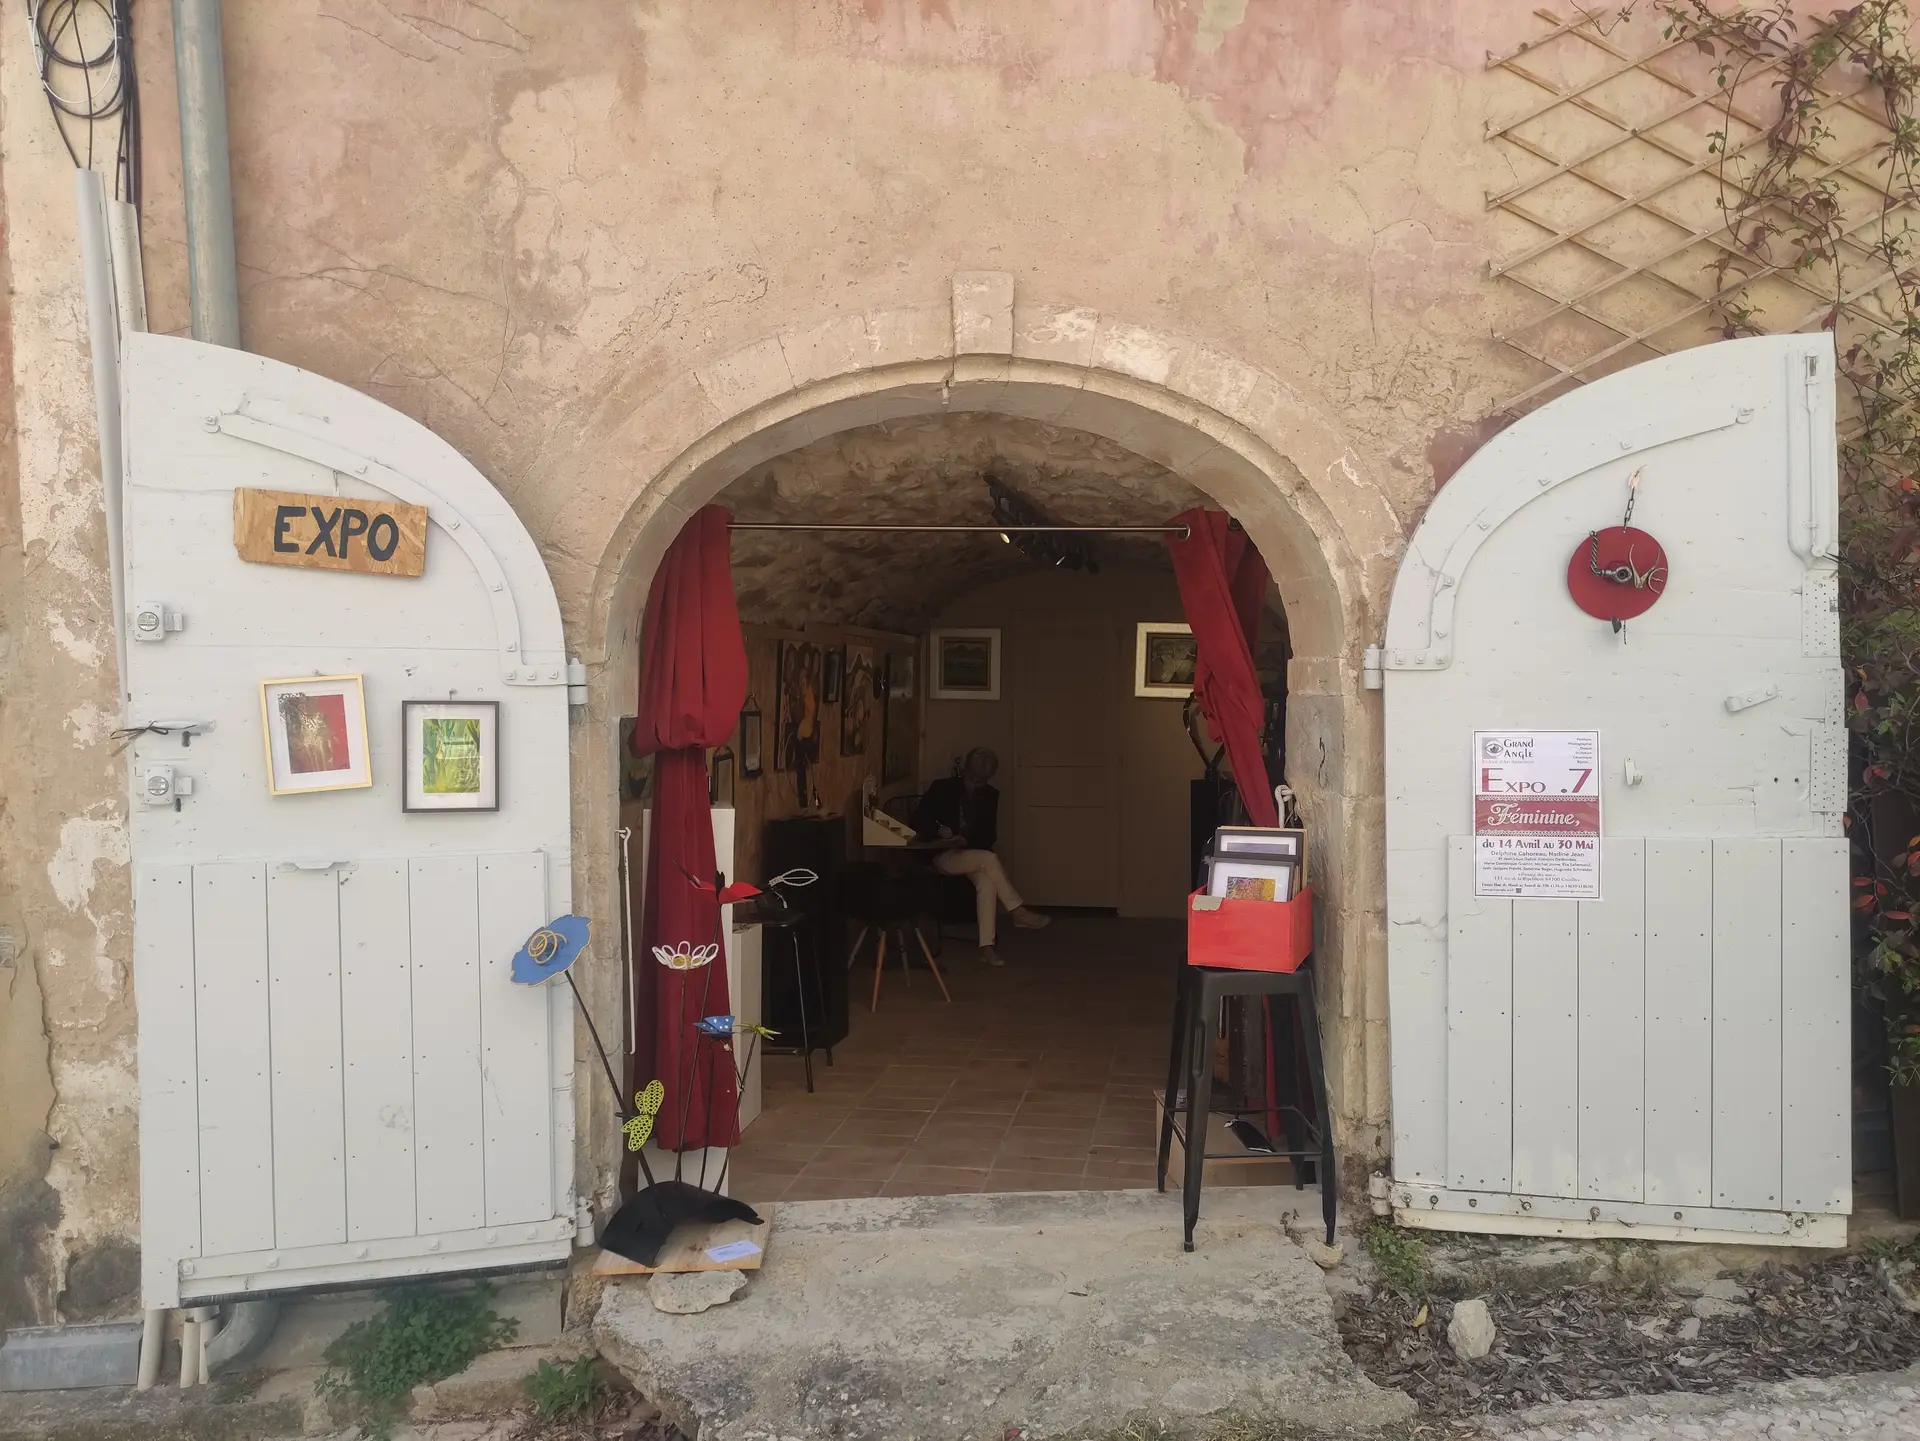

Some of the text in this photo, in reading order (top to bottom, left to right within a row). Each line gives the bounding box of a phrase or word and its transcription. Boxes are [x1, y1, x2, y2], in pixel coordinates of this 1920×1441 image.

[273, 505, 399, 562] EXPO
[1487, 802, 1581, 827] Féminine,
[1482, 839, 1495, 848] du
[1498, 839, 1513, 849] 14
[1557, 839, 1573, 850] 30
